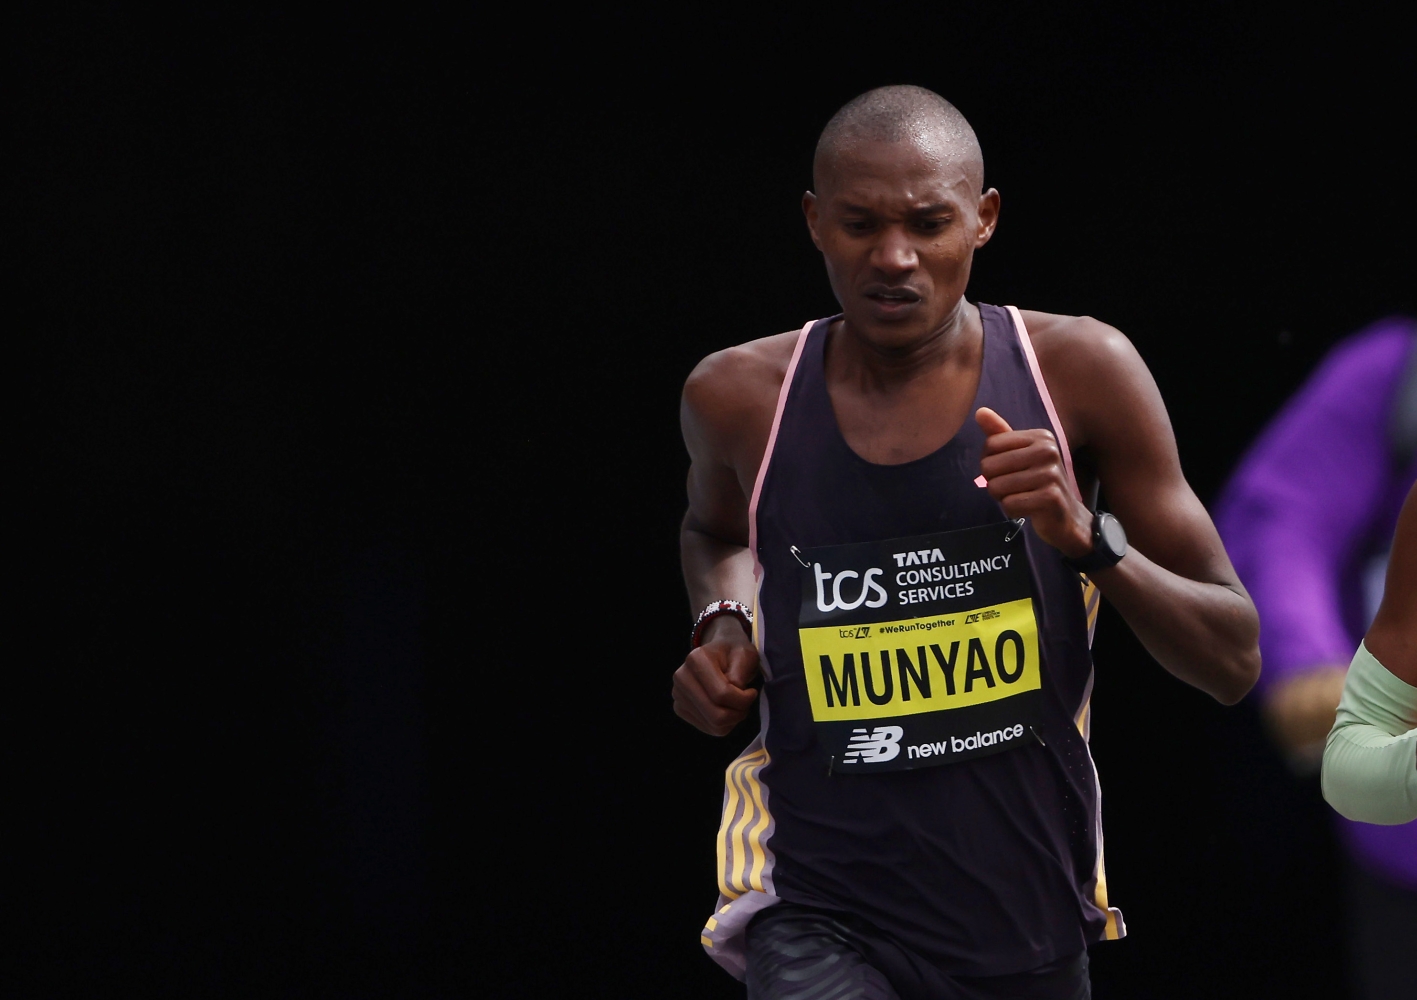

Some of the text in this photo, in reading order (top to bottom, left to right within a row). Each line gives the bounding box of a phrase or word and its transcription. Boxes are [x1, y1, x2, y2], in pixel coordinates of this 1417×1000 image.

[893, 548, 945, 567] TATA
[896, 554, 1012, 586] CONSULTANCY
[814, 562, 888, 612] tcs
[898, 581, 975, 606] SERVICES
[880, 619, 955, 634] #WeRunTogether
[819, 629, 1025, 708] MUNYAO
[843, 725, 904, 764] NB
[907, 723, 1024, 760] new balance
